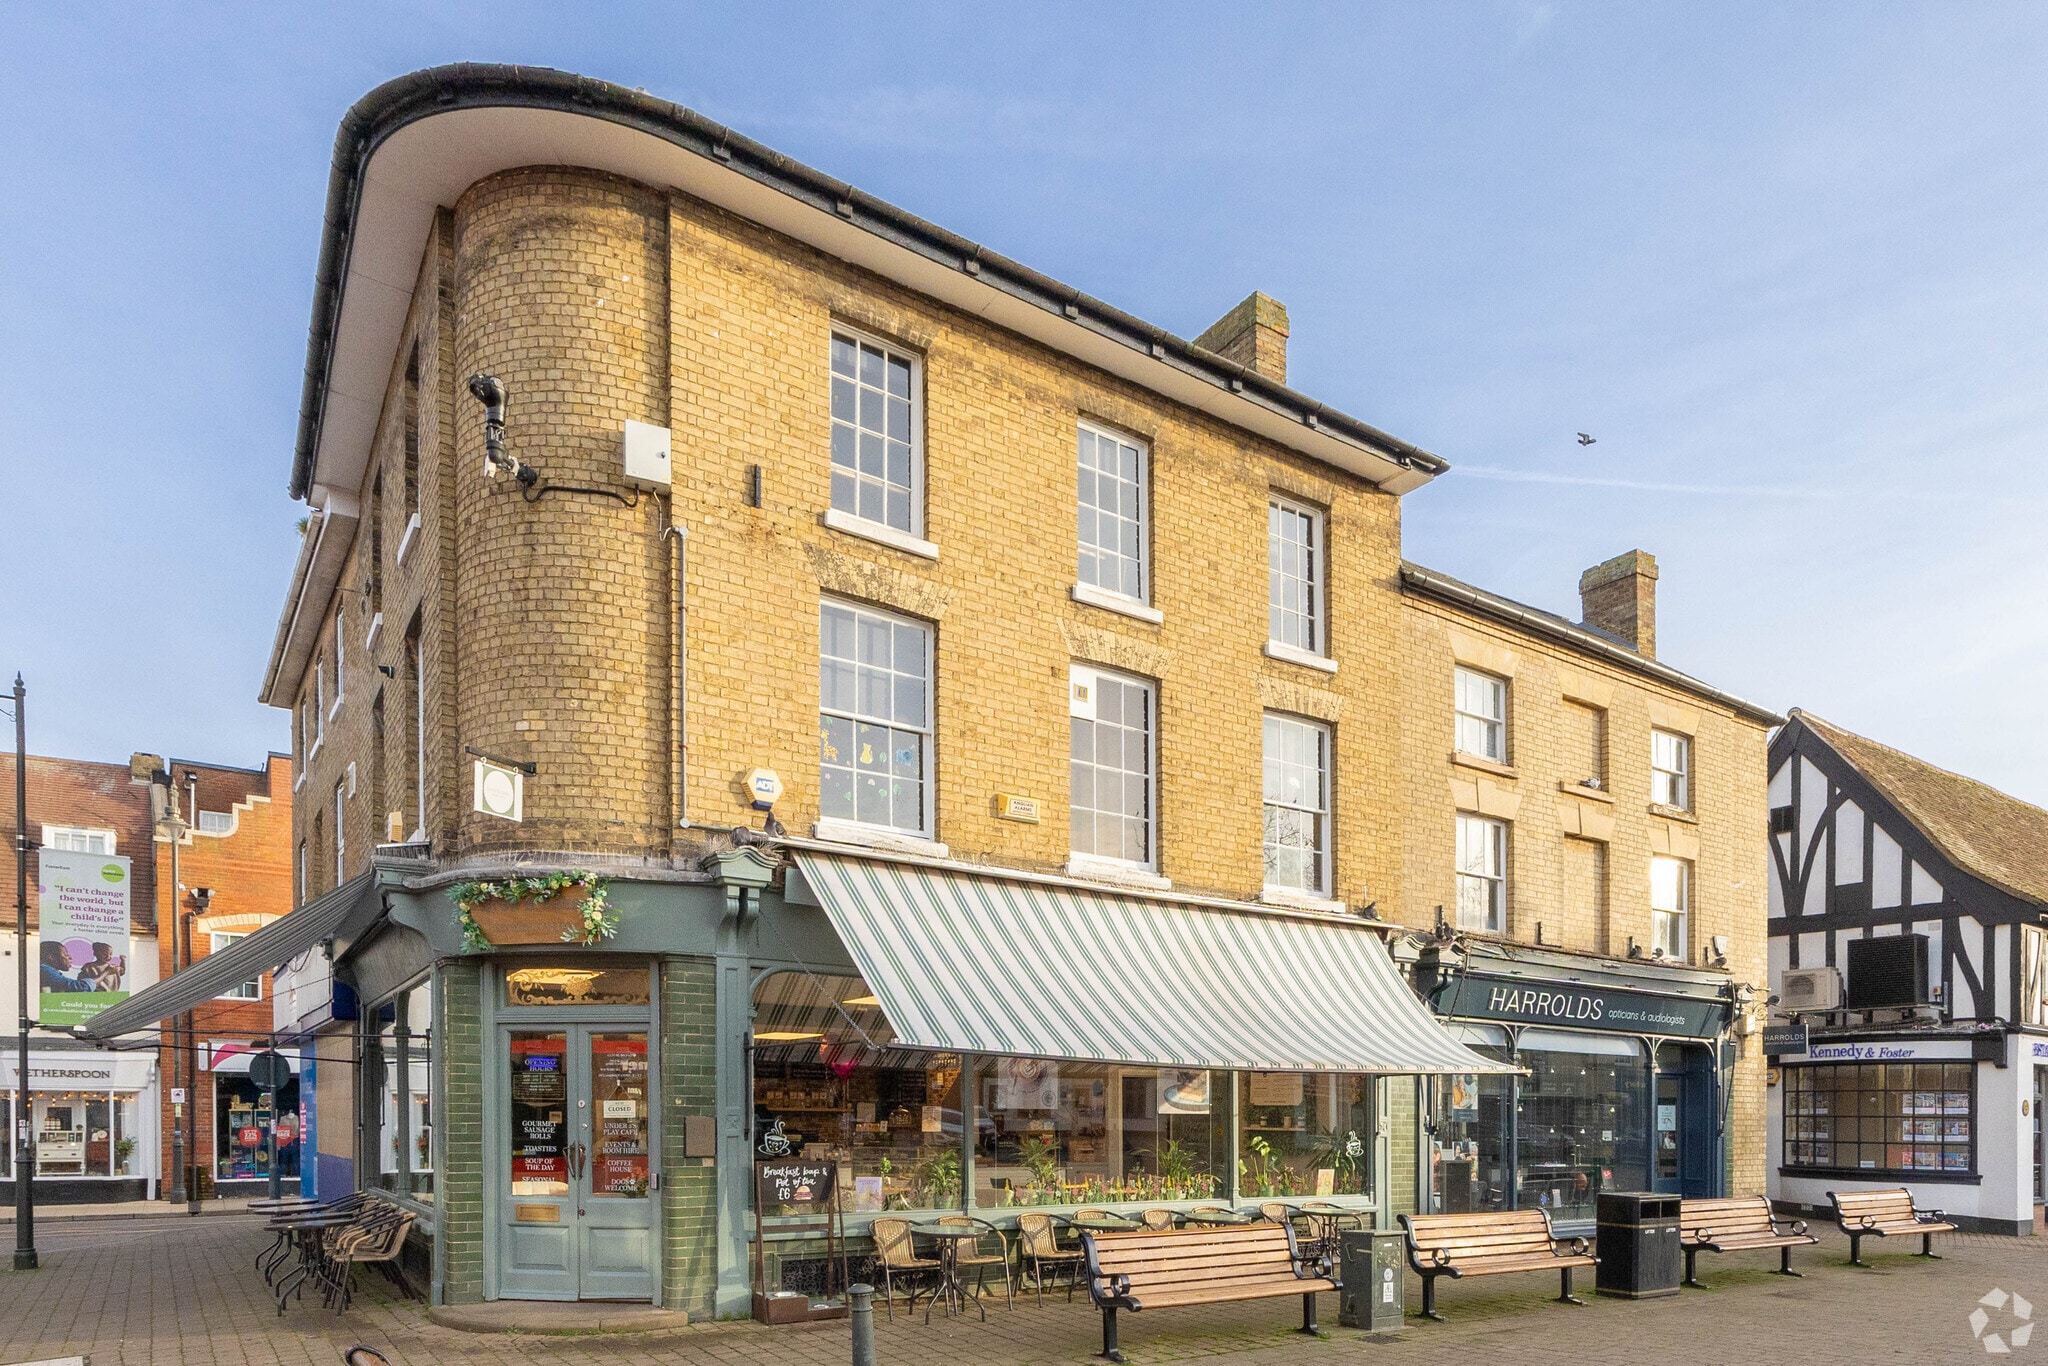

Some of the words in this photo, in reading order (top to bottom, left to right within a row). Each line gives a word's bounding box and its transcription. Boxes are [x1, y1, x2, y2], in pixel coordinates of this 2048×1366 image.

[91, 889, 124, 898] change
[77, 896, 106, 905] world,
[83, 905, 117, 915] change
[1488, 987, 1604, 1021] HARROLDS
[1608, 1008, 1639, 1021] opticians
[1639, 1011, 1646, 1021] &
[1647, 1012, 1686, 1026] audiologists
[1764, 1033, 1805, 1042] HARROLDS
[1809, 1044, 1863, 1059] Kennedy
[1865, 1047, 1875, 1058] &
[1878, 1047, 1914, 1058] Foster
[763, 1165, 800, 1178] Breakfast
[822, 1167, 828, 1176] &
[792, 1177, 801, 1188] of
[778, 1187, 791, 1200] £6
